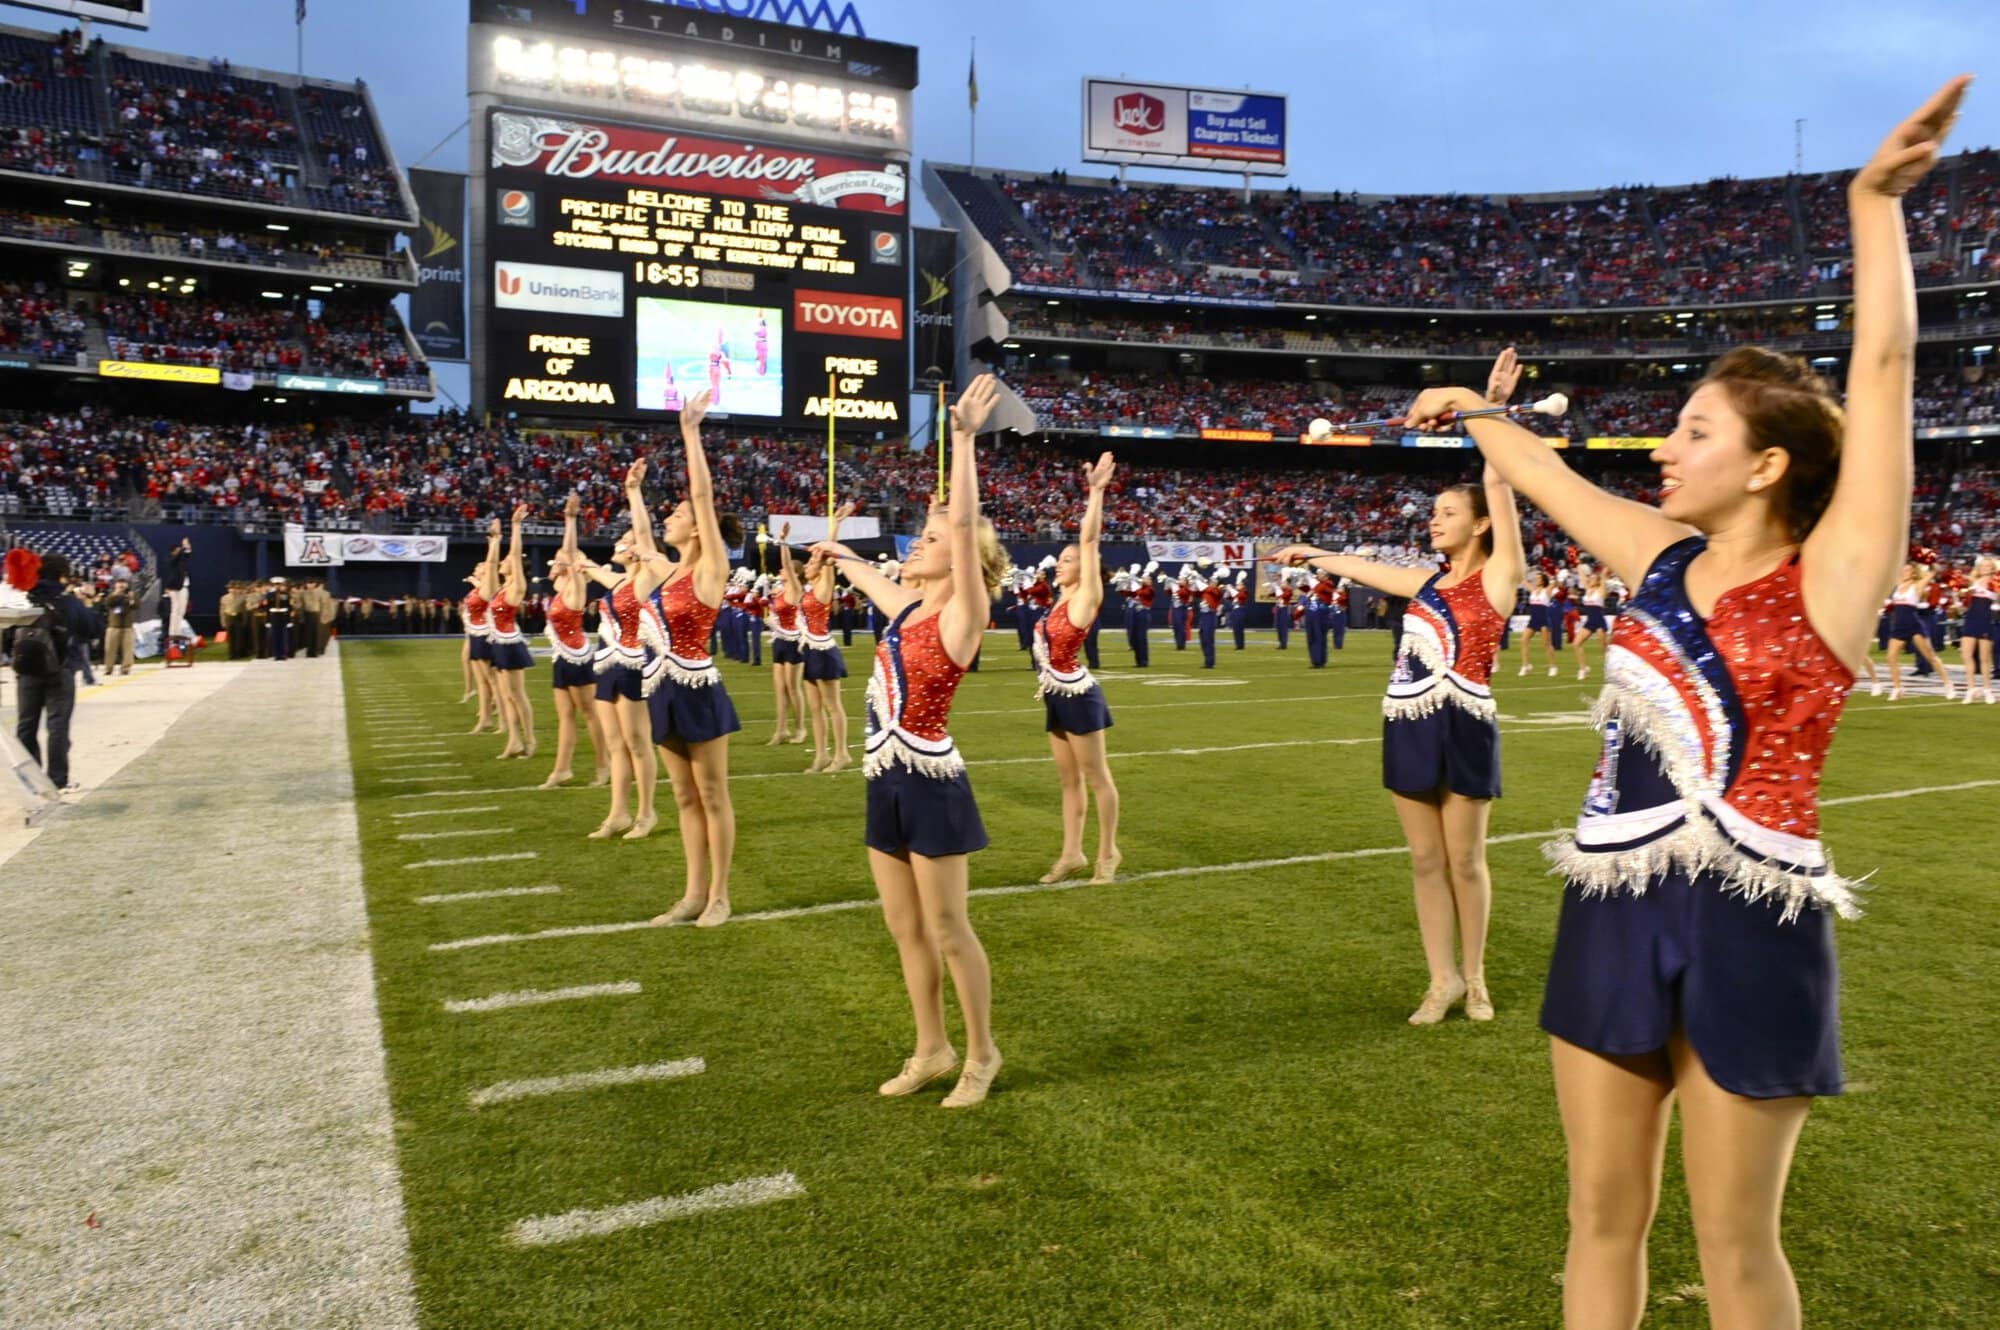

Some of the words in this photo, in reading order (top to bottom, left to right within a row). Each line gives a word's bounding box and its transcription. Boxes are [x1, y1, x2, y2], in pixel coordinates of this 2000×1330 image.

[612, 9, 841, 59] STADIUM
[1116, 97, 1162, 130] Jack
[1207, 113, 1226, 129] Buy
[1227, 117, 1246, 128] and
[1247, 117, 1267, 130] Sell
[1194, 126, 1239, 143] Chargers
[531, 129, 816, 182] Budweiser
[818, 177, 869, 197] American
[870, 178, 901, 194] Lager
[627, 188, 712, 213] WELCOME
[720, 200, 746, 217] TO
[753, 203, 790, 222] THE
[560, 198, 648, 223] PACIFIC
[655, 208, 706, 229] LIFE
[713, 215, 794, 238] HOLIDAY
[800, 224, 847, 244] BOWL
[700, 232, 781, 252] PRESENTED
[811, 243, 839, 258] THE
[635, 260, 700, 288] 16:55
[528, 280, 620, 300] UnionBank
[799, 301, 899, 330] TOYOTA
[914, 309, 953, 328] Sprint
[528, 333, 591, 356] PRIDE
[545, 357, 575, 376] OF
[824, 355, 878, 376] PRIDE
[503, 377, 616, 405] ARIZONA
[838, 377, 865, 394] OF
[803, 396, 899, 421] ARIZONA
[300, 534, 331, 565] A
[1222, 544, 1245, 566] N
